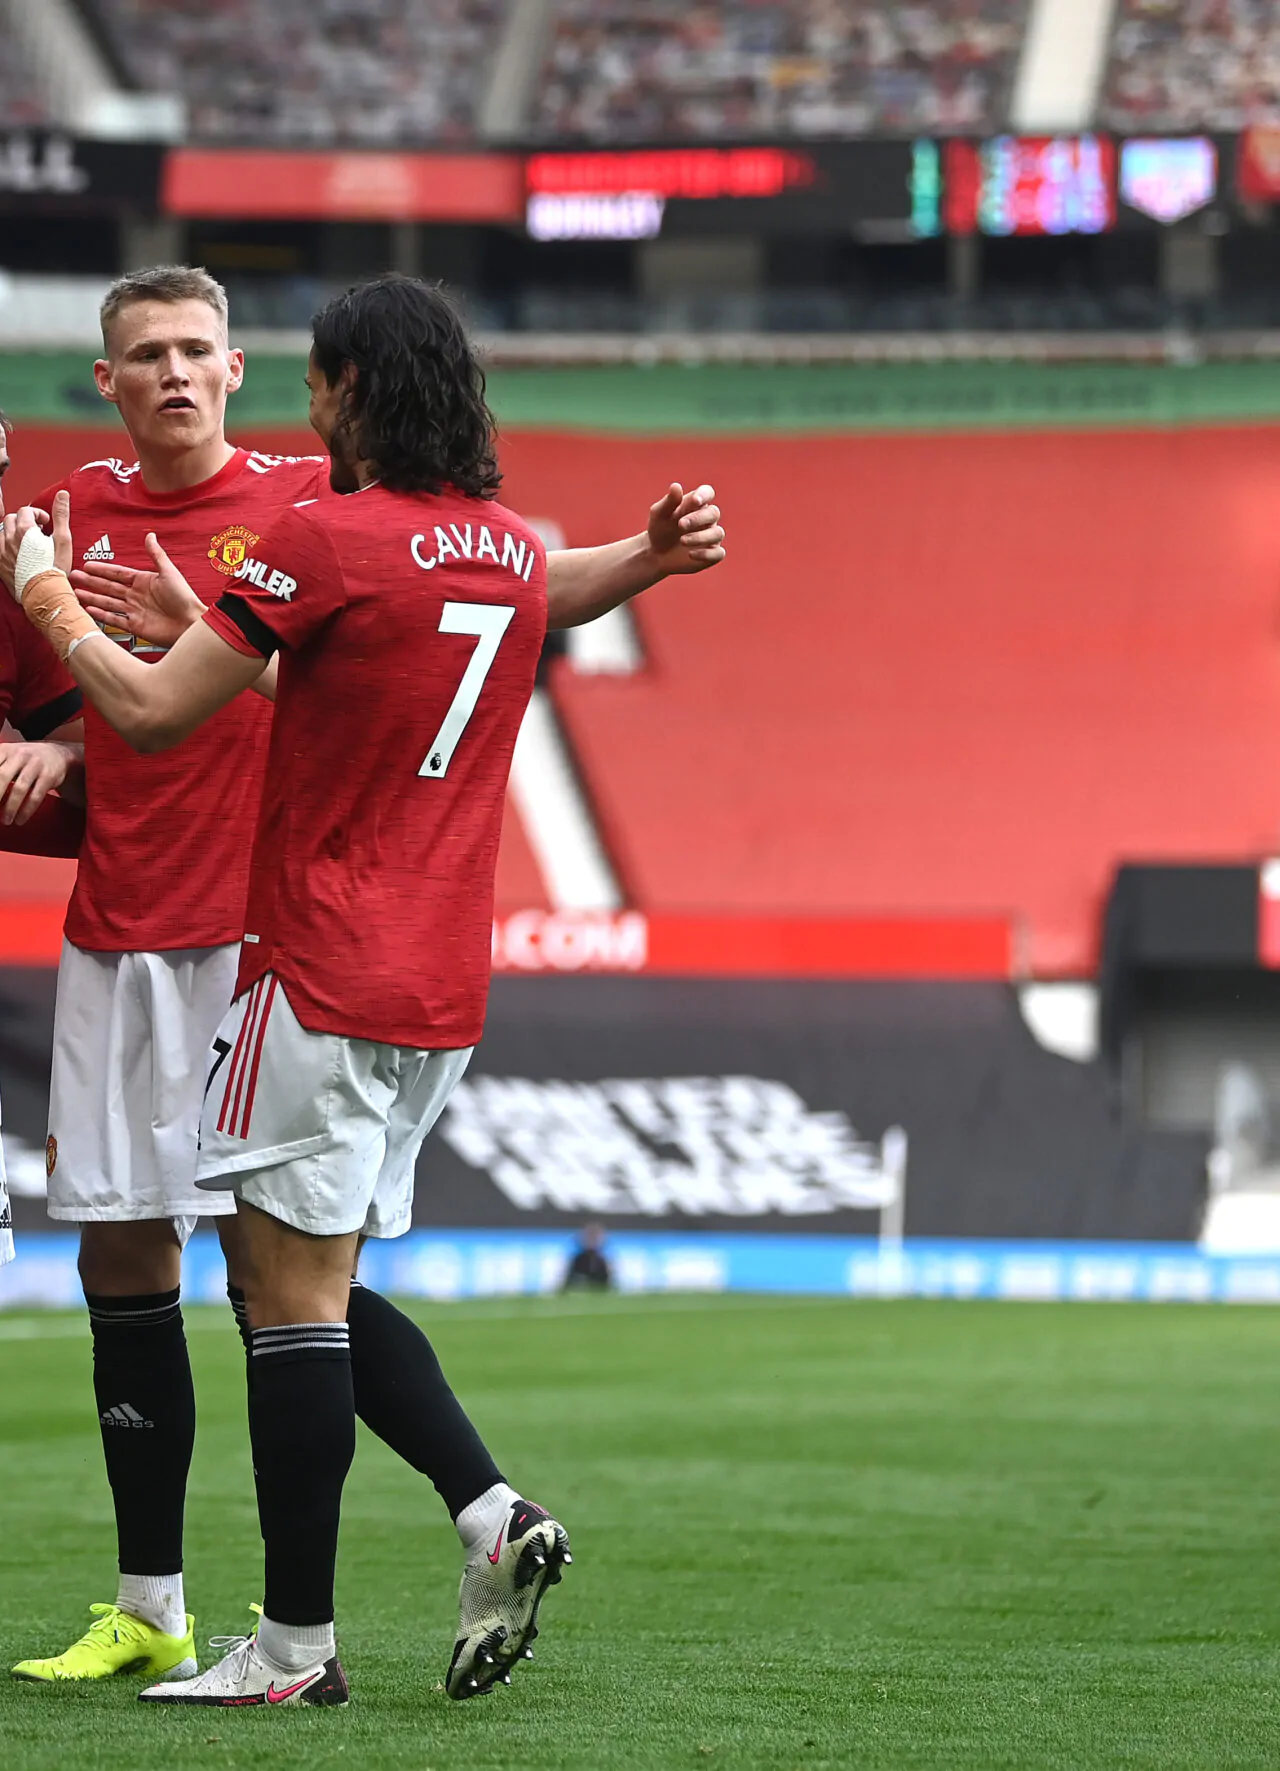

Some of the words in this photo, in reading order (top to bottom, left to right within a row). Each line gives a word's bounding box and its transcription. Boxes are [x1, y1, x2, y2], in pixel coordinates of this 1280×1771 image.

[83, 550, 115, 560] adidas
[410, 523, 535, 582] CAVANI
[234, 557, 297, 602] OHLER
[417, 601, 516, 778] 7
